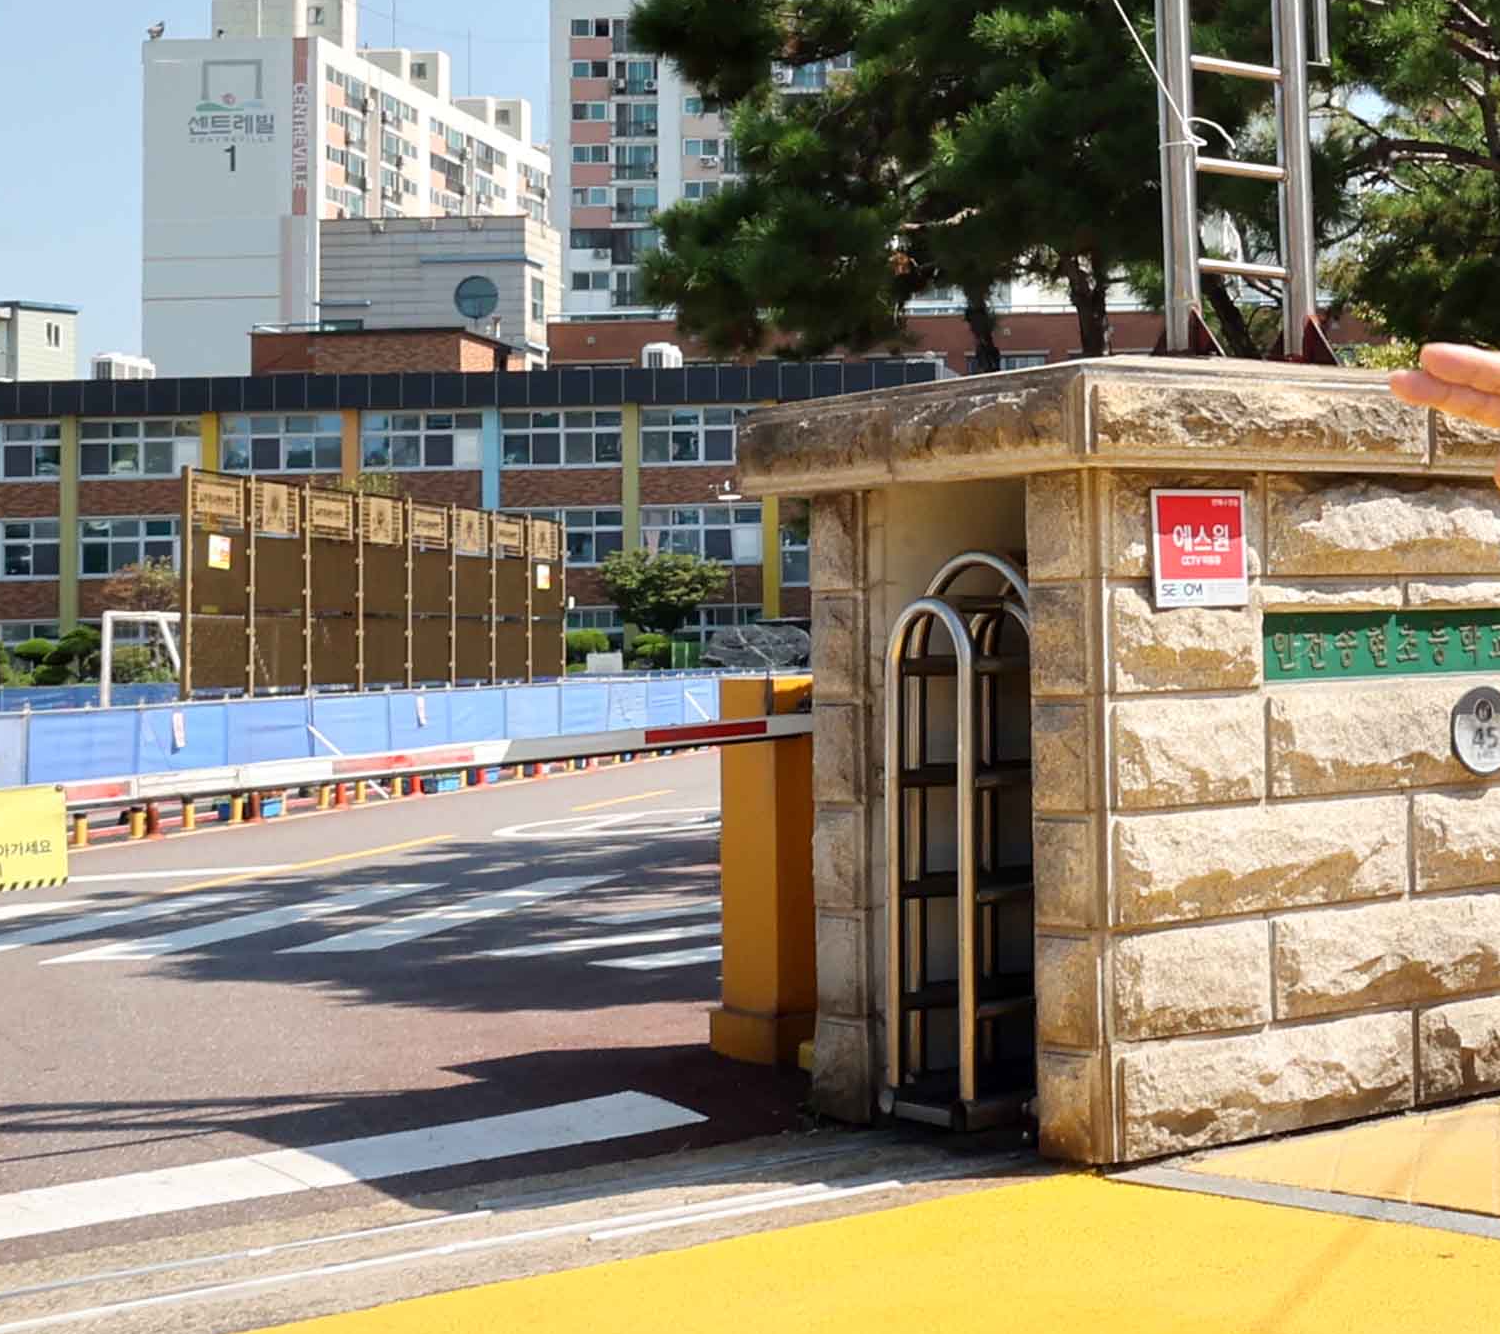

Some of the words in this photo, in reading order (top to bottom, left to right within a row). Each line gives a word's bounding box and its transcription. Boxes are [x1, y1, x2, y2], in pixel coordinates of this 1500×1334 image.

[188, 115, 274, 135] 센트레빌
[223, 144, 237, 172] 1
[1172, 523, 1230, 553] 에스원
[1472, 726, 1499, 749] 45
